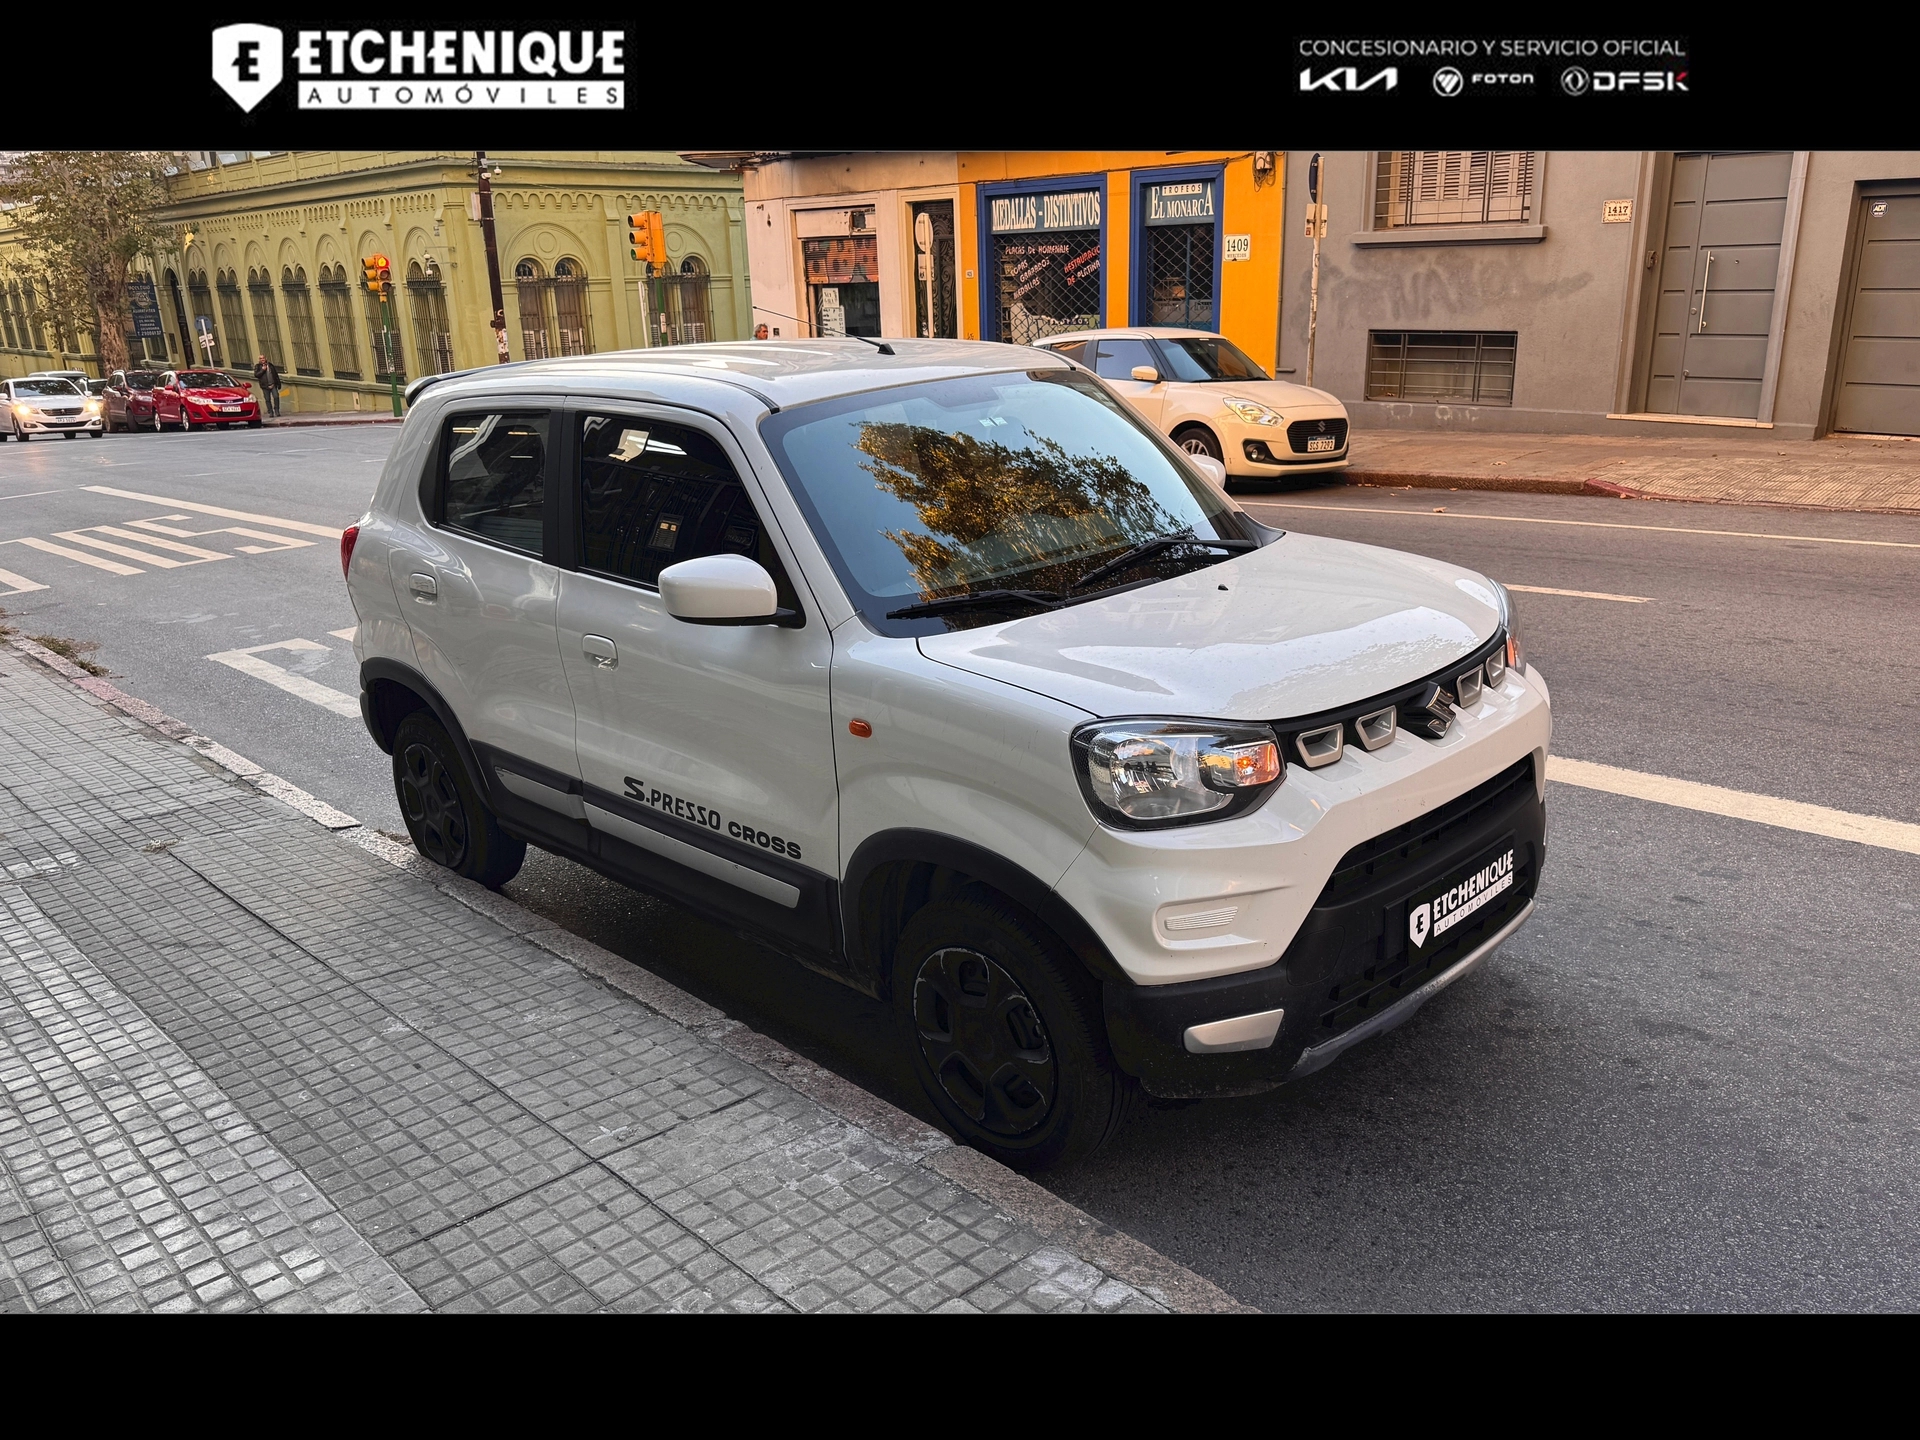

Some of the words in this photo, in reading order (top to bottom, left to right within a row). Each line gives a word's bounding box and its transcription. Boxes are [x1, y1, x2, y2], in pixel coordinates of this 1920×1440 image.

[1163, 184, 1202, 195] TROFEOS
[1166, 182, 1214, 218] MONARCA
[992, 196, 1037, 231] MEDALLAS
[1043, 190, 1101, 228] DISTINTIVOS
[1607, 205, 1629, 214] 1417
[1226, 238, 1249, 252] 1409
[728, 821, 802, 860] CROSS
